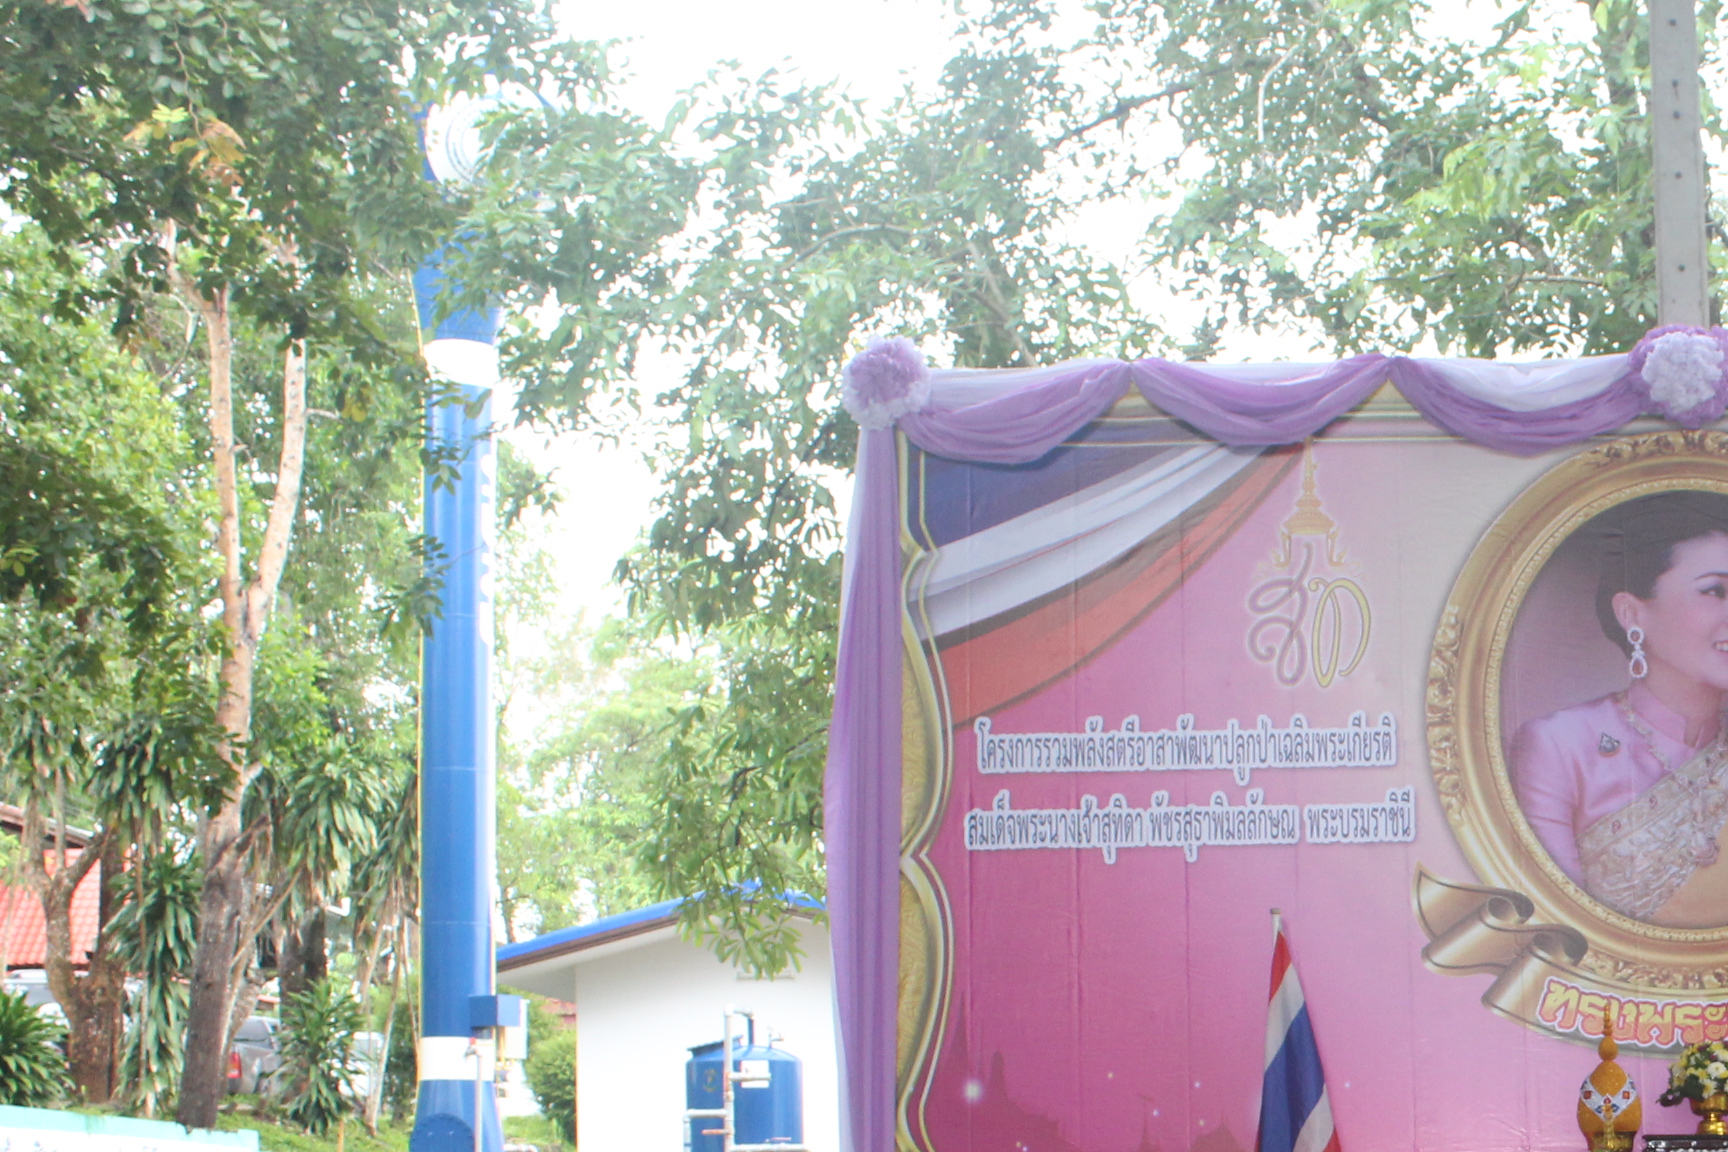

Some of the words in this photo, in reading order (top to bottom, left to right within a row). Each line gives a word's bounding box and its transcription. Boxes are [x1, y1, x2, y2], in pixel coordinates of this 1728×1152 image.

[976, 713, 1396, 784] โครงการรวมพลังสตรีอาสาพัฒนาปลูกป่าเฉลิมพระเกียรติ
[967, 792, 1145, 862] สมเด็จพระนางเจ้าสุทิดา
[1149, 791, 1296, 861] พัชรสุธาพิมลลักษณ
[1307, 788, 1413, 841] พระบรมราชินี
